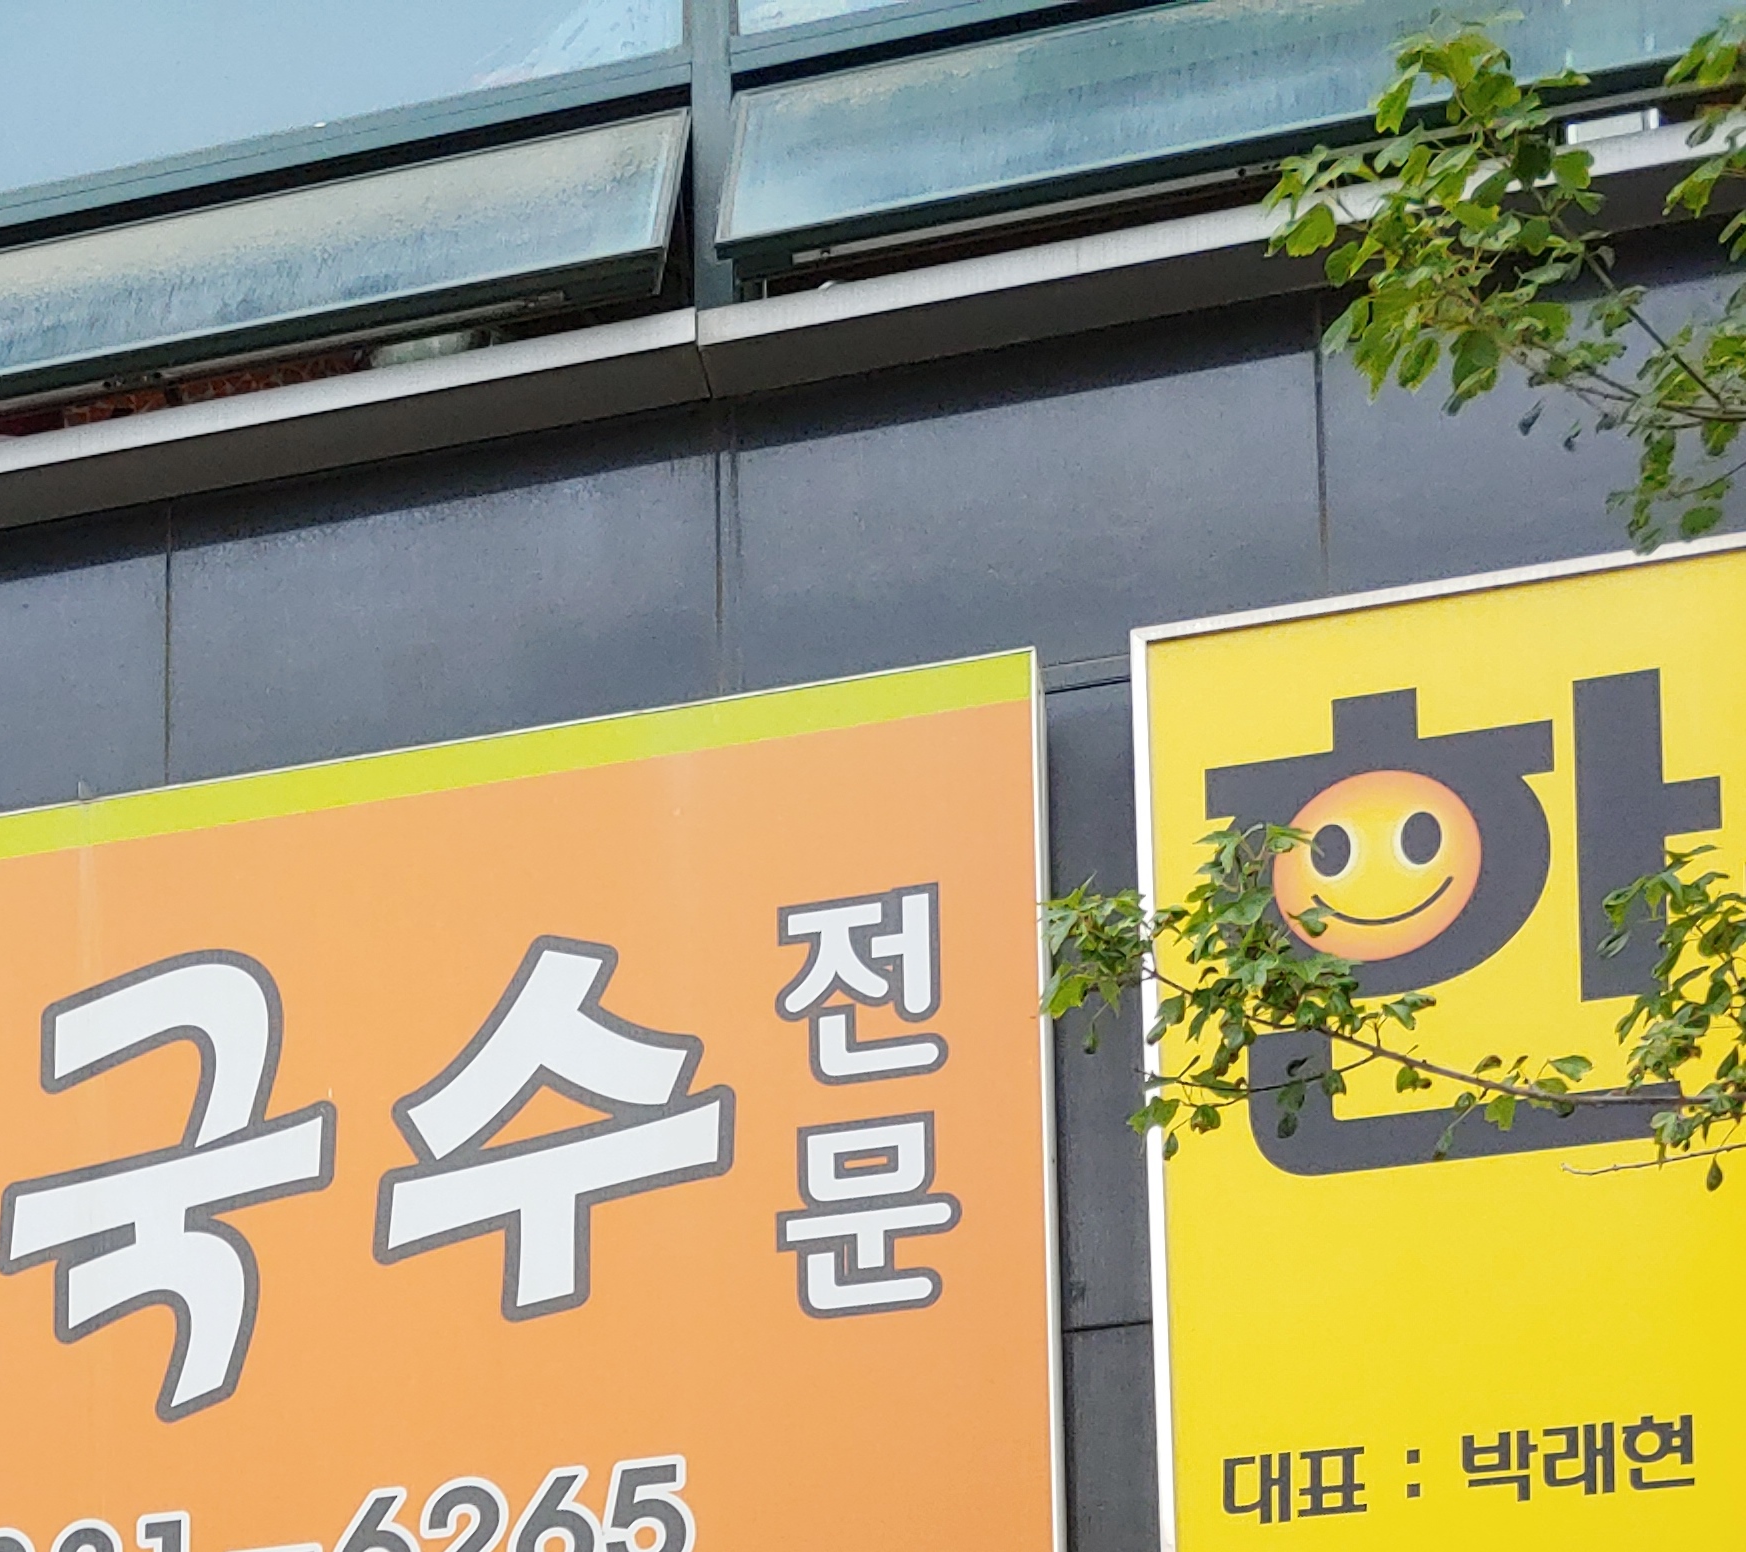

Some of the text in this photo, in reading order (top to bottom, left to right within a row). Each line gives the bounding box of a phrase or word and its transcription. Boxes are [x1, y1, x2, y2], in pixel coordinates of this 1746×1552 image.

[775, 882, 961, 1319] 전문
[1205, 667, 1724, 1175] 한
[1221, 1445, 1368, 1524] 대표
[1462, 1414, 1696, 1502] 박래현
